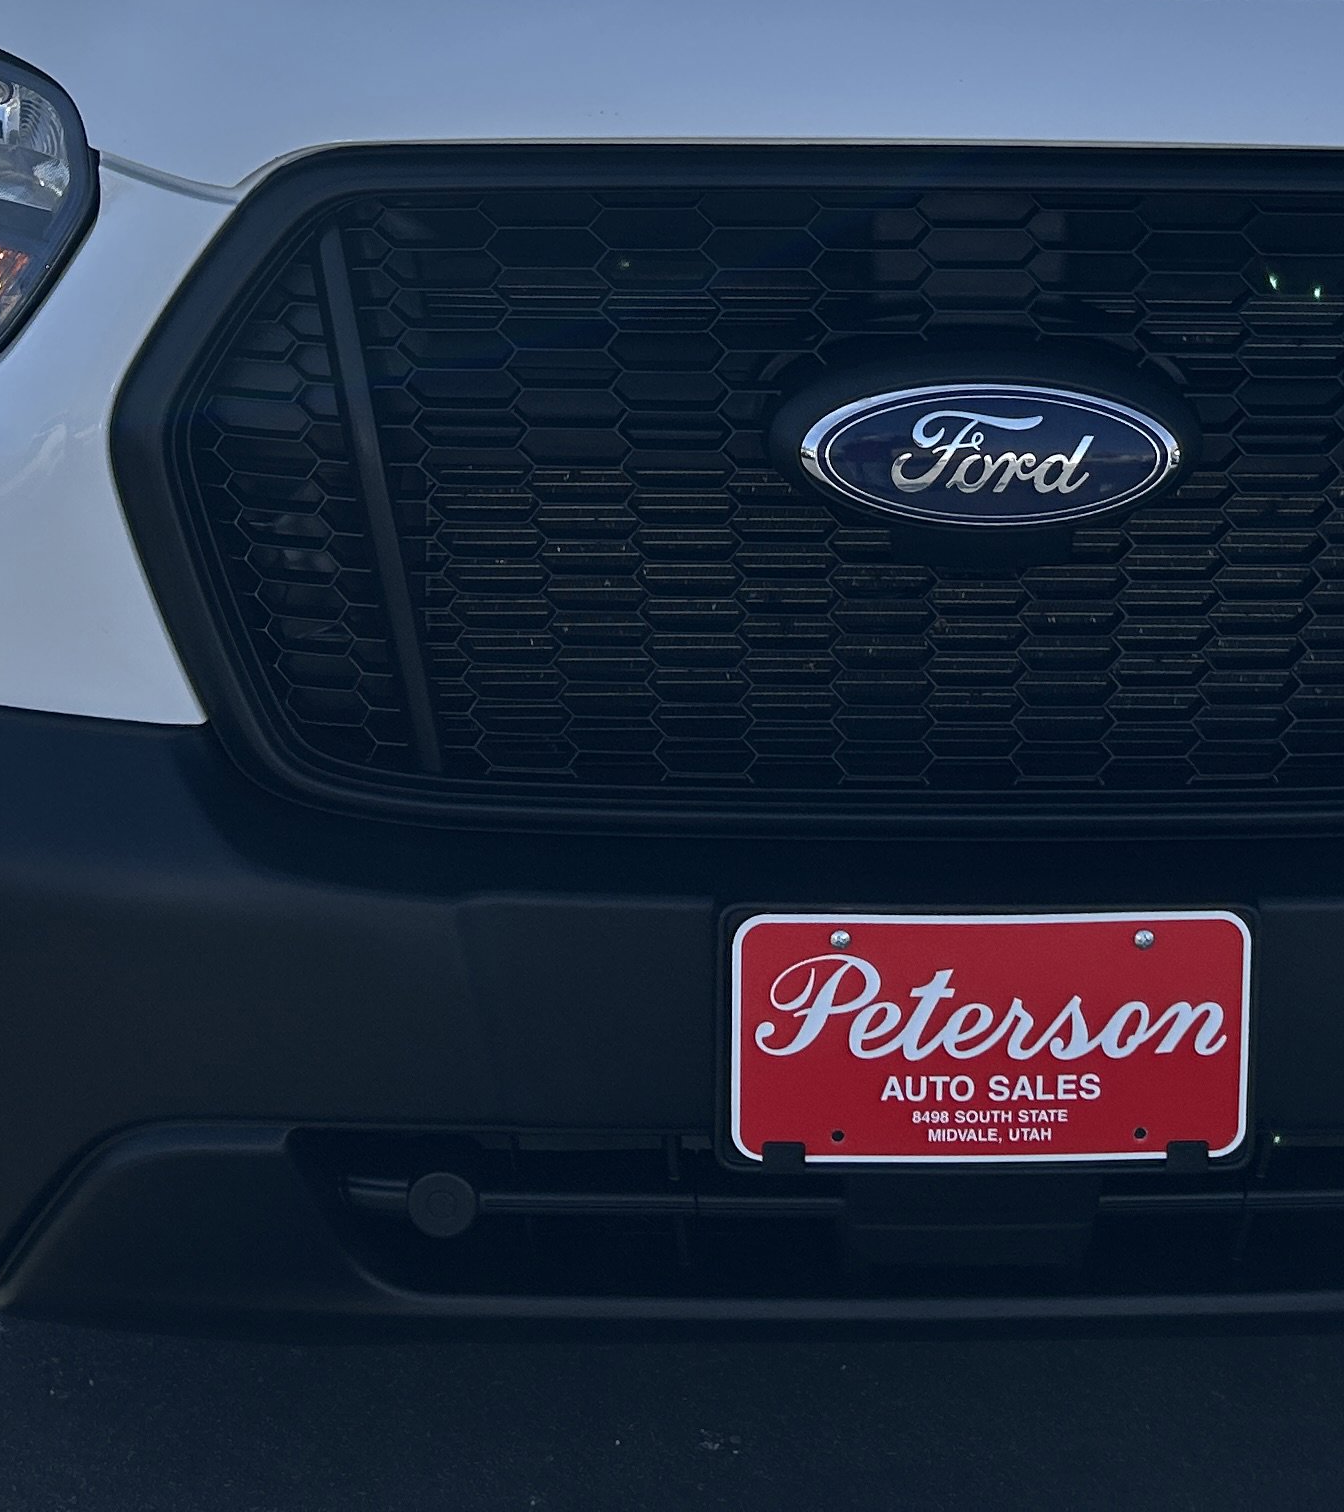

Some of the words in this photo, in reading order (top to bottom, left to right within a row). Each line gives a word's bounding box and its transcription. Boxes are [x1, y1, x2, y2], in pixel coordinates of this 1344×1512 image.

[890, 409, 1095, 494] Ford
[754, 953, 1228, 1062] Peterson
[880, 1075, 975, 1102] AUTO
[988, 1073, 1101, 1101] SALES
[911, 1110, 950, 1124] 8498
[954, 1109, 1013, 1124] SOUTH
[1017, 1109, 1068, 1123] STATE
[927, 1128, 1003, 1144] MIDVALE,
[1008, 1127, 1052, 1142] UTAH
